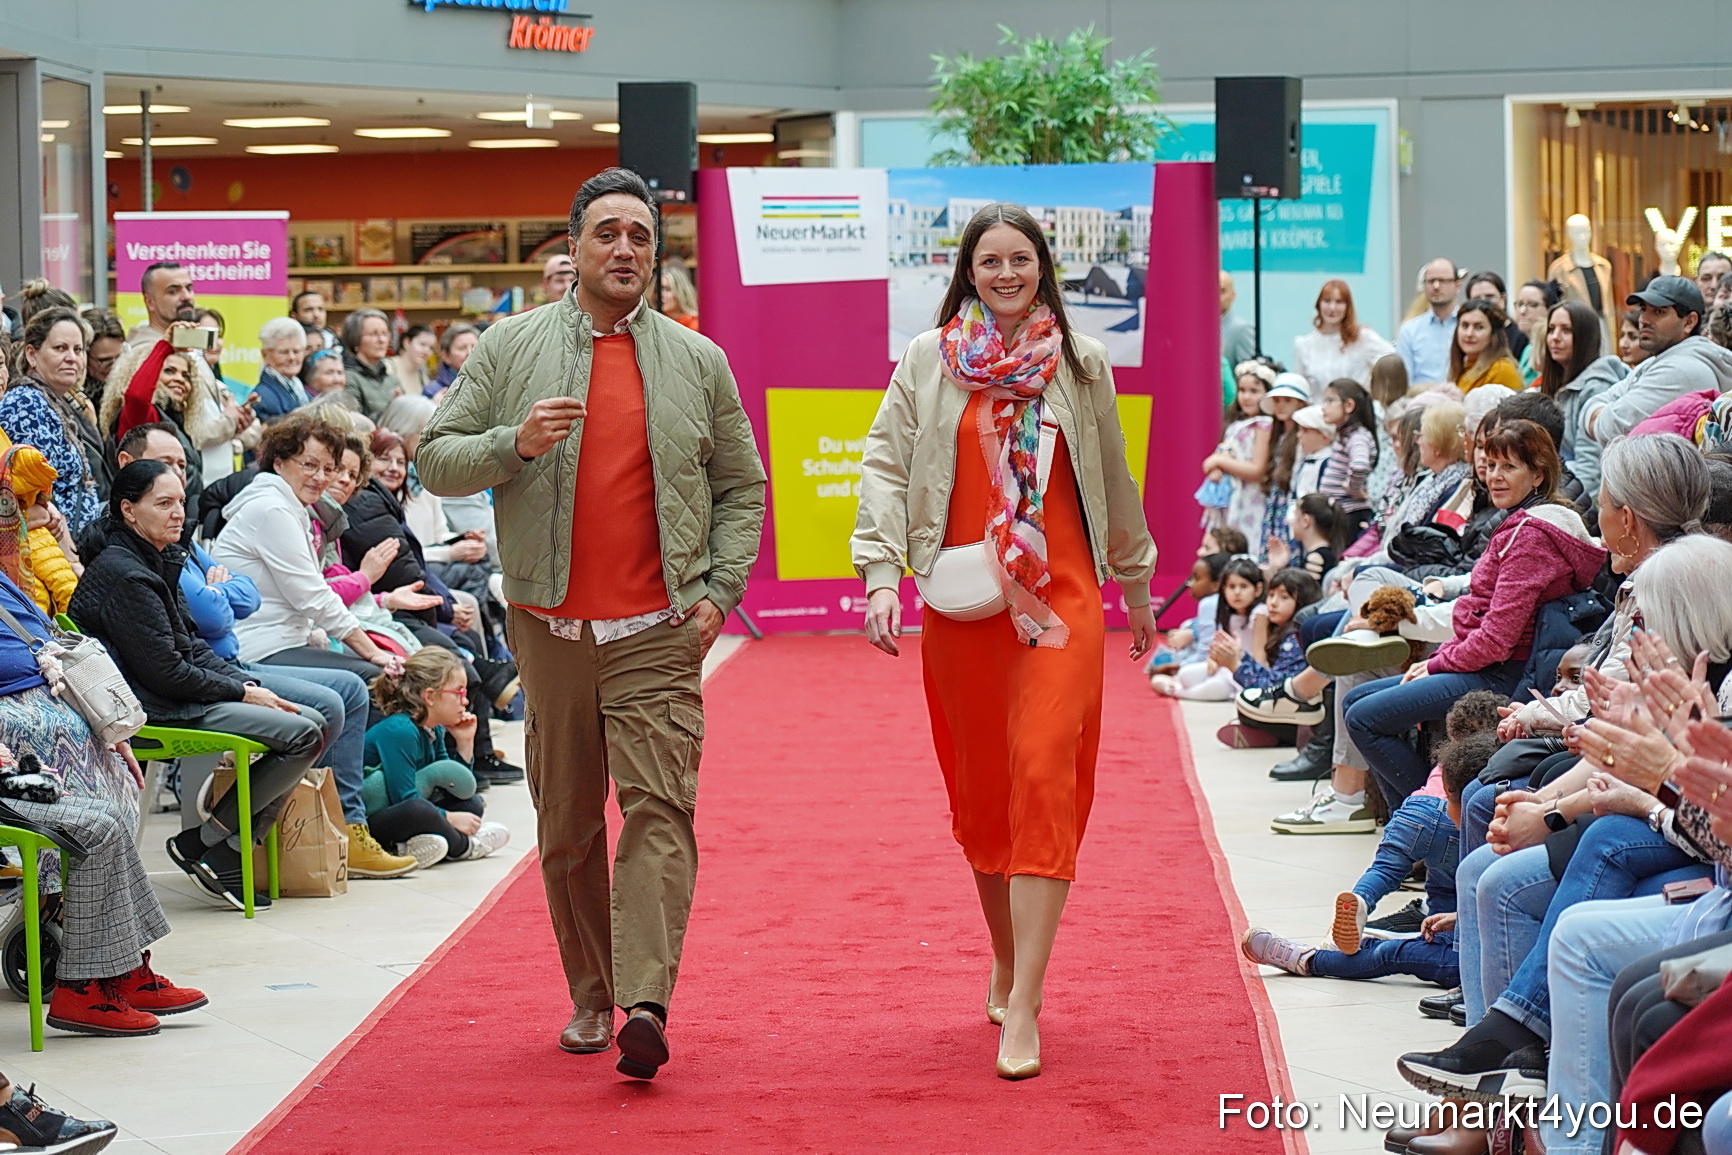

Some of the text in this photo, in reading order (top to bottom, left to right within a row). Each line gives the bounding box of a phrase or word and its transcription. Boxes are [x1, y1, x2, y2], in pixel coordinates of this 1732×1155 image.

[509, 15, 595, 52] Krömer
[757, 224, 866, 240] NeuerMarkt
[126, 240, 271, 261] Verschenken Sie
[186, 261, 271, 281] tscheine!
[818, 436, 843, 454] Du
[816, 479, 851, 498] und
